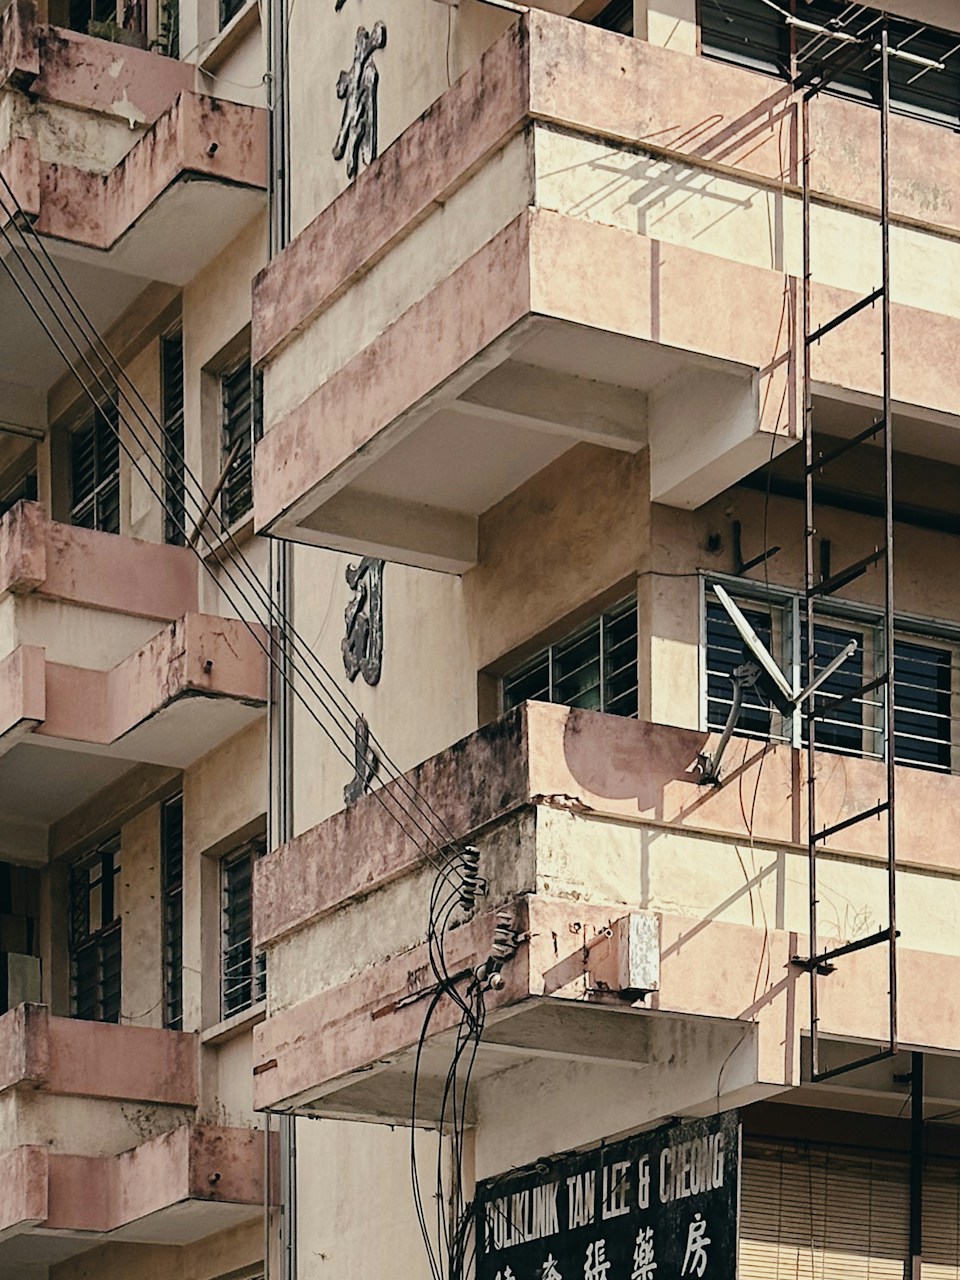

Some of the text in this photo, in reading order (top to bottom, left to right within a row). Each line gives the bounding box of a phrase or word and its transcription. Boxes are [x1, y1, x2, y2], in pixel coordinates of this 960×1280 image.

[566, 1170, 596, 1230] TAN
[602, 1160, 632, 1221] LEE
[638, 1153, 651, 1210] &
[659, 1131, 725, 1204] CHEONG
